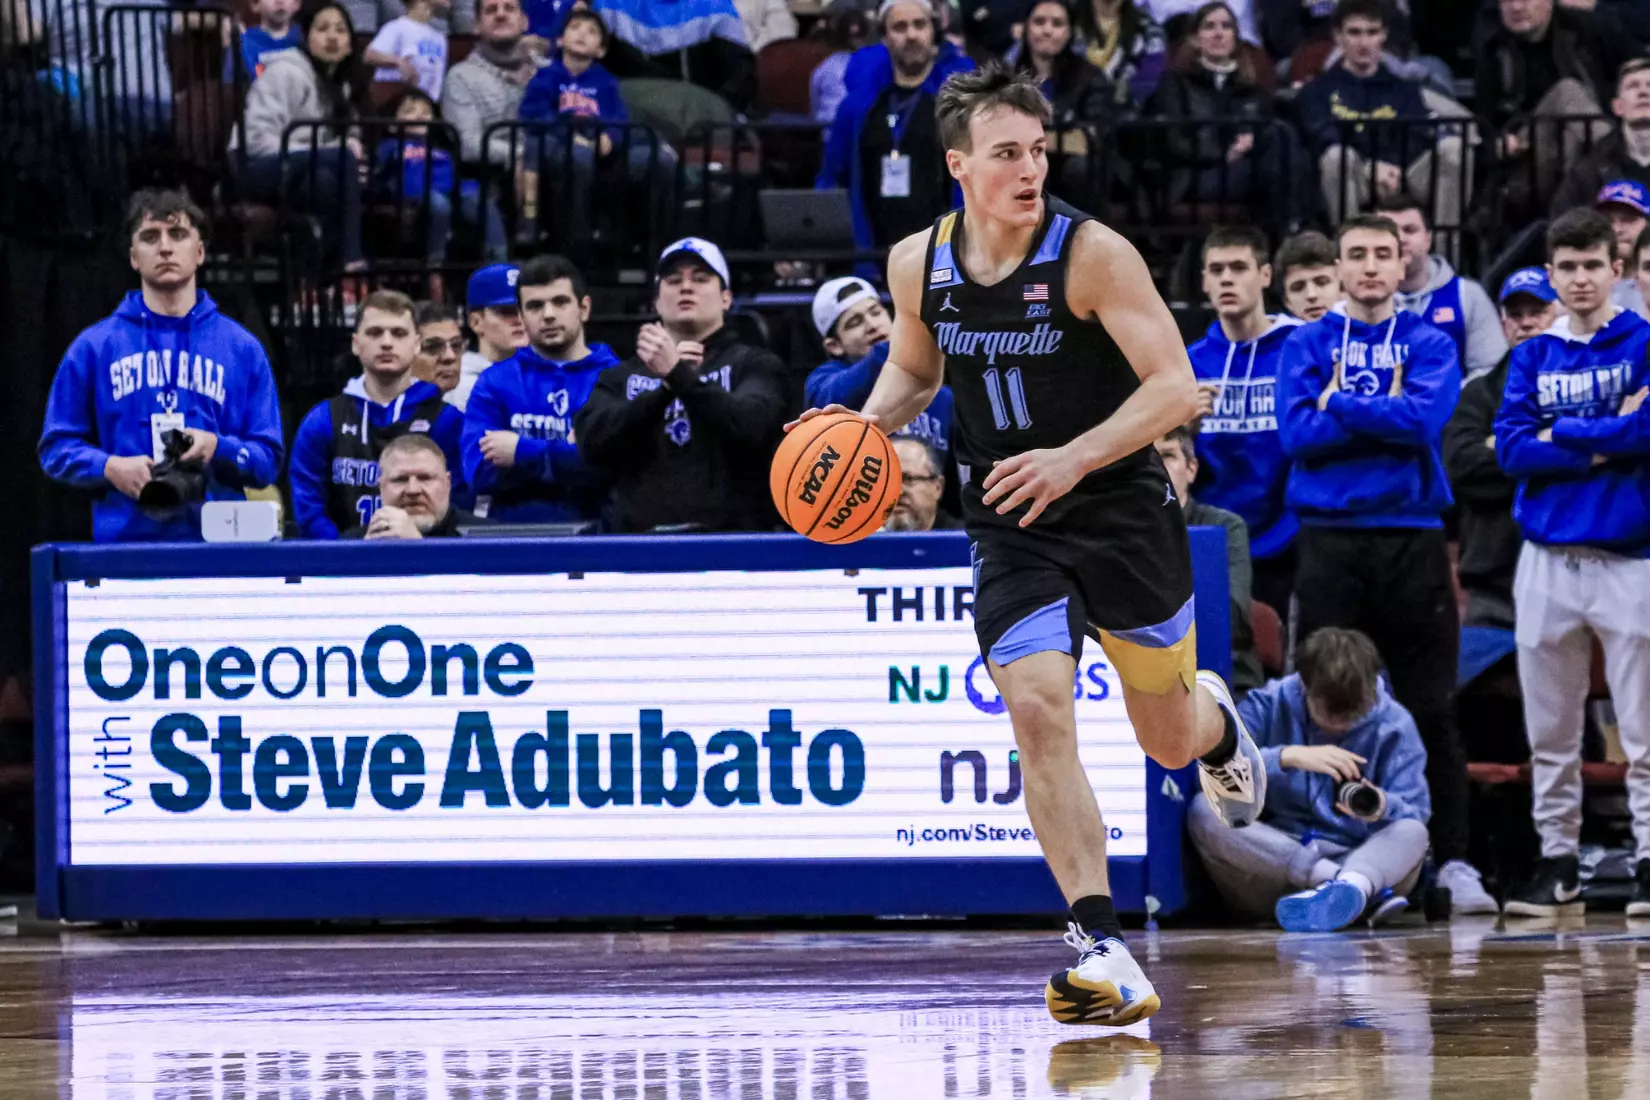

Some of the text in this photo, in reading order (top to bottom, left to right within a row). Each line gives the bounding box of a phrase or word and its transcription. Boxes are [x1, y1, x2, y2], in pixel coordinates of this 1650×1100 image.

[933, 322, 1064, 365] Marquette
[109, 349, 172, 402] SETON
[982, 366, 1033, 430] 11
[332, 456, 380, 487] SETO
[799, 445, 841, 505] NCAA
[826, 455, 882, 530] Wilson
[857, 586, 975, 622] THIR
[889, 665, 950, 704] NJ
[94, 716, 134, 814] with
[150, 708, 866, 812] Steve Adubato
